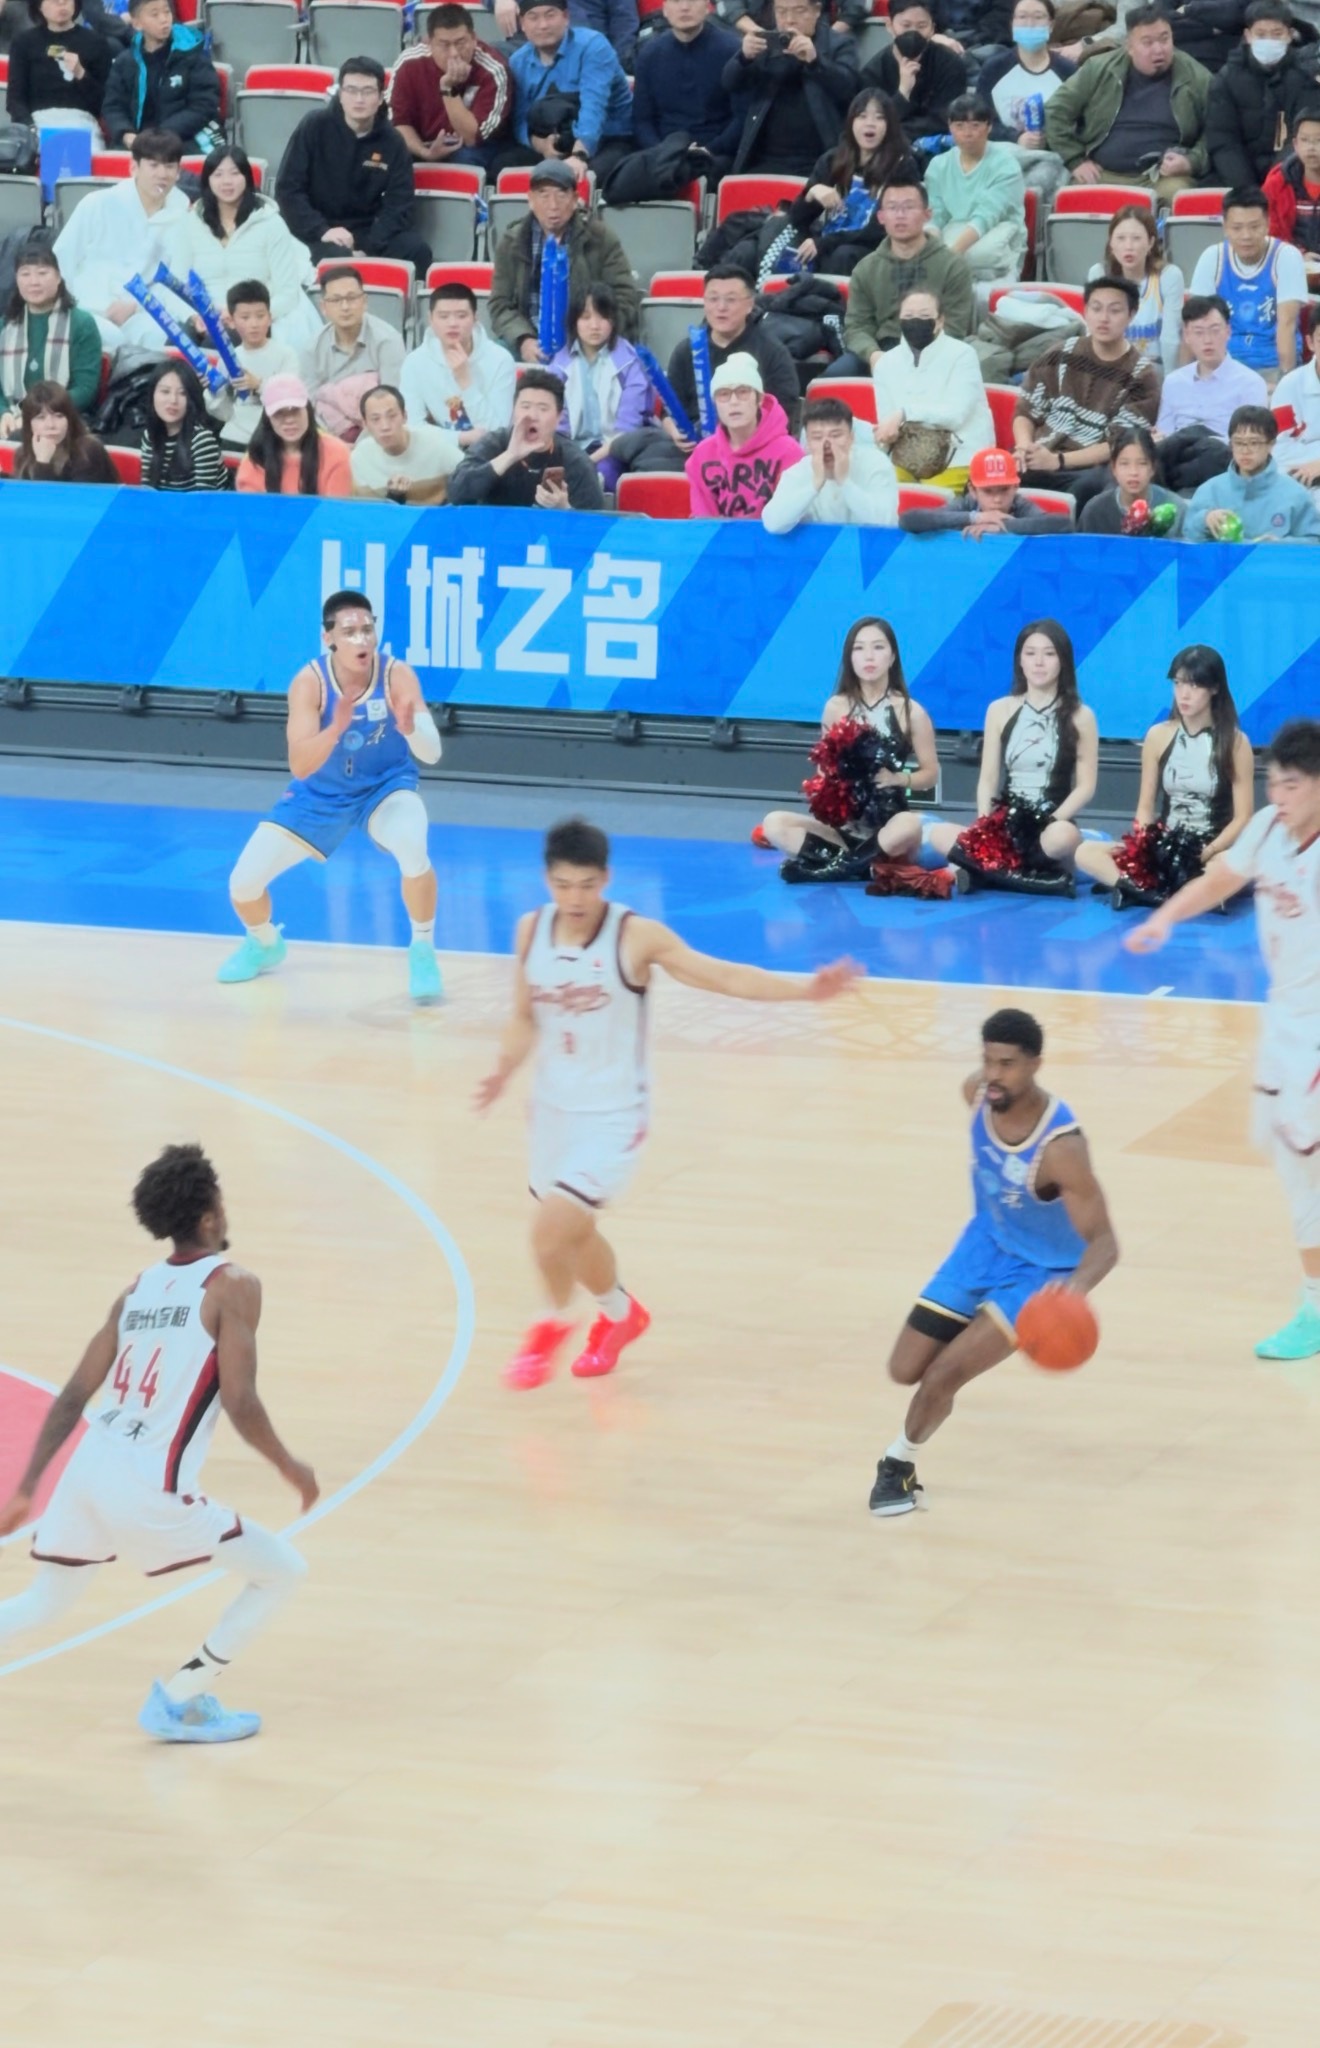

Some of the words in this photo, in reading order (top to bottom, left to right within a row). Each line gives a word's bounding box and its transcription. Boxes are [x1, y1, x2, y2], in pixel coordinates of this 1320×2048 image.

[320, 539, 662, 680] 以城之名
[113, 1344, 162, 1409] 44
